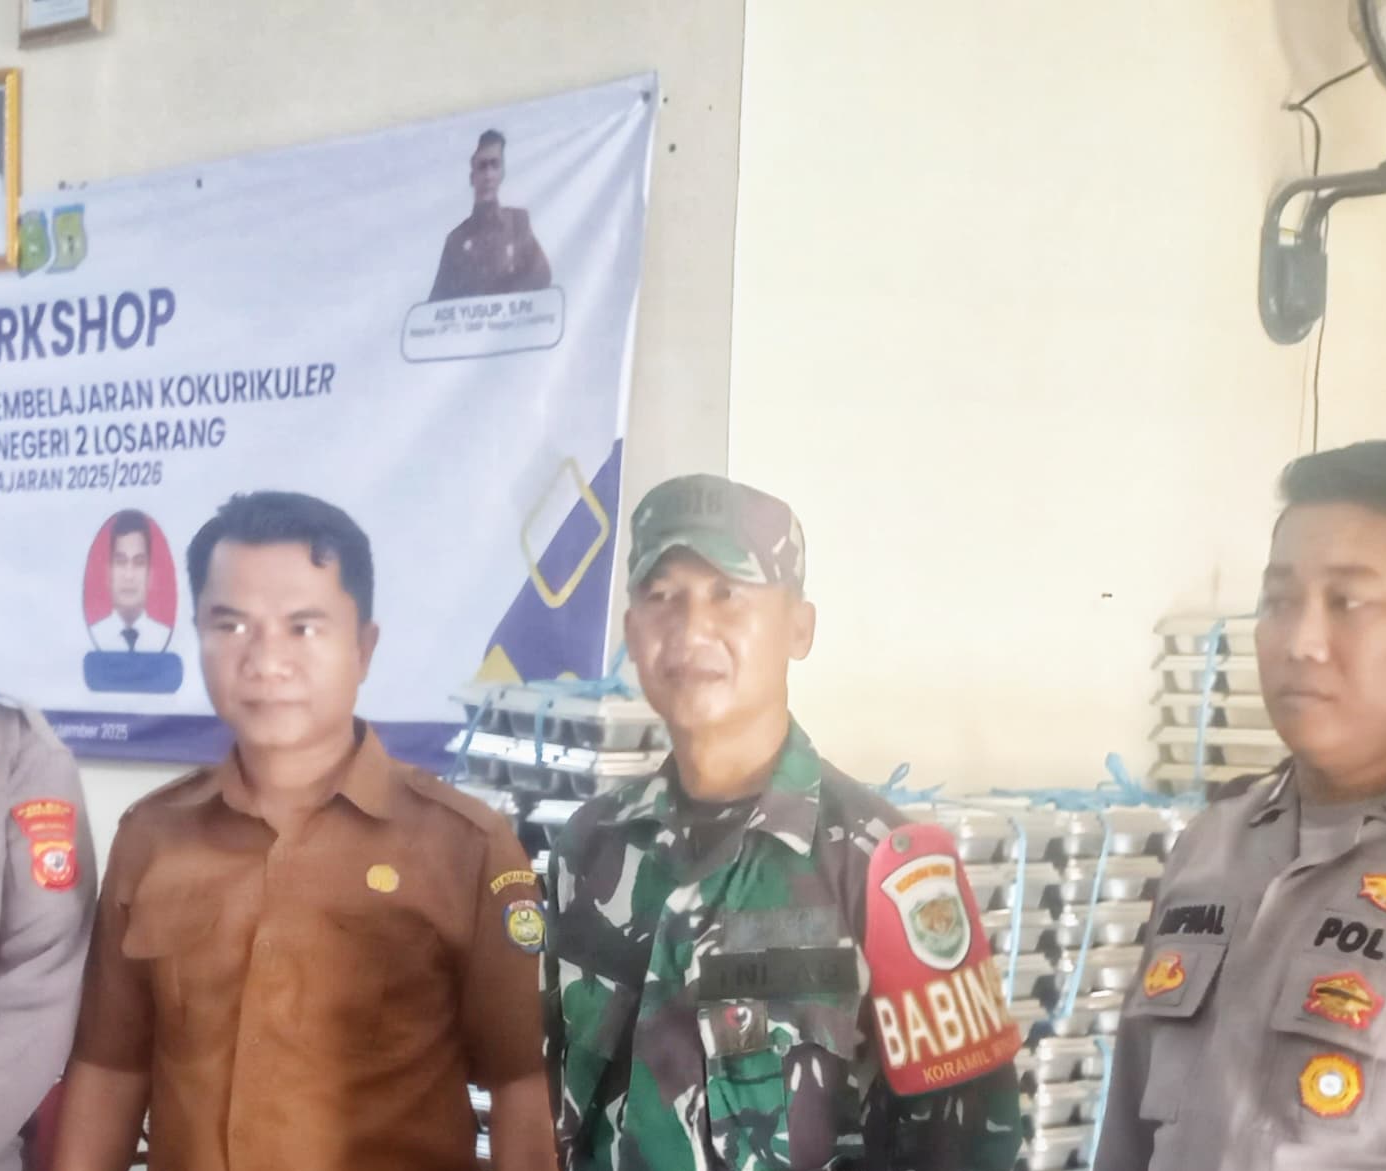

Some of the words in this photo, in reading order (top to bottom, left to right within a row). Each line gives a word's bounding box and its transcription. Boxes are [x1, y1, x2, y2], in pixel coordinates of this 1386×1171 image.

[160, 363, 335, 408] KOKURIKULER
[75, 425, 88, 456] 2
[95, 417, 226, 456] LOSARANG
[66, 458, 163, 491] 2025/2026
[922, 1048, 990, 1086] KORAMIL
